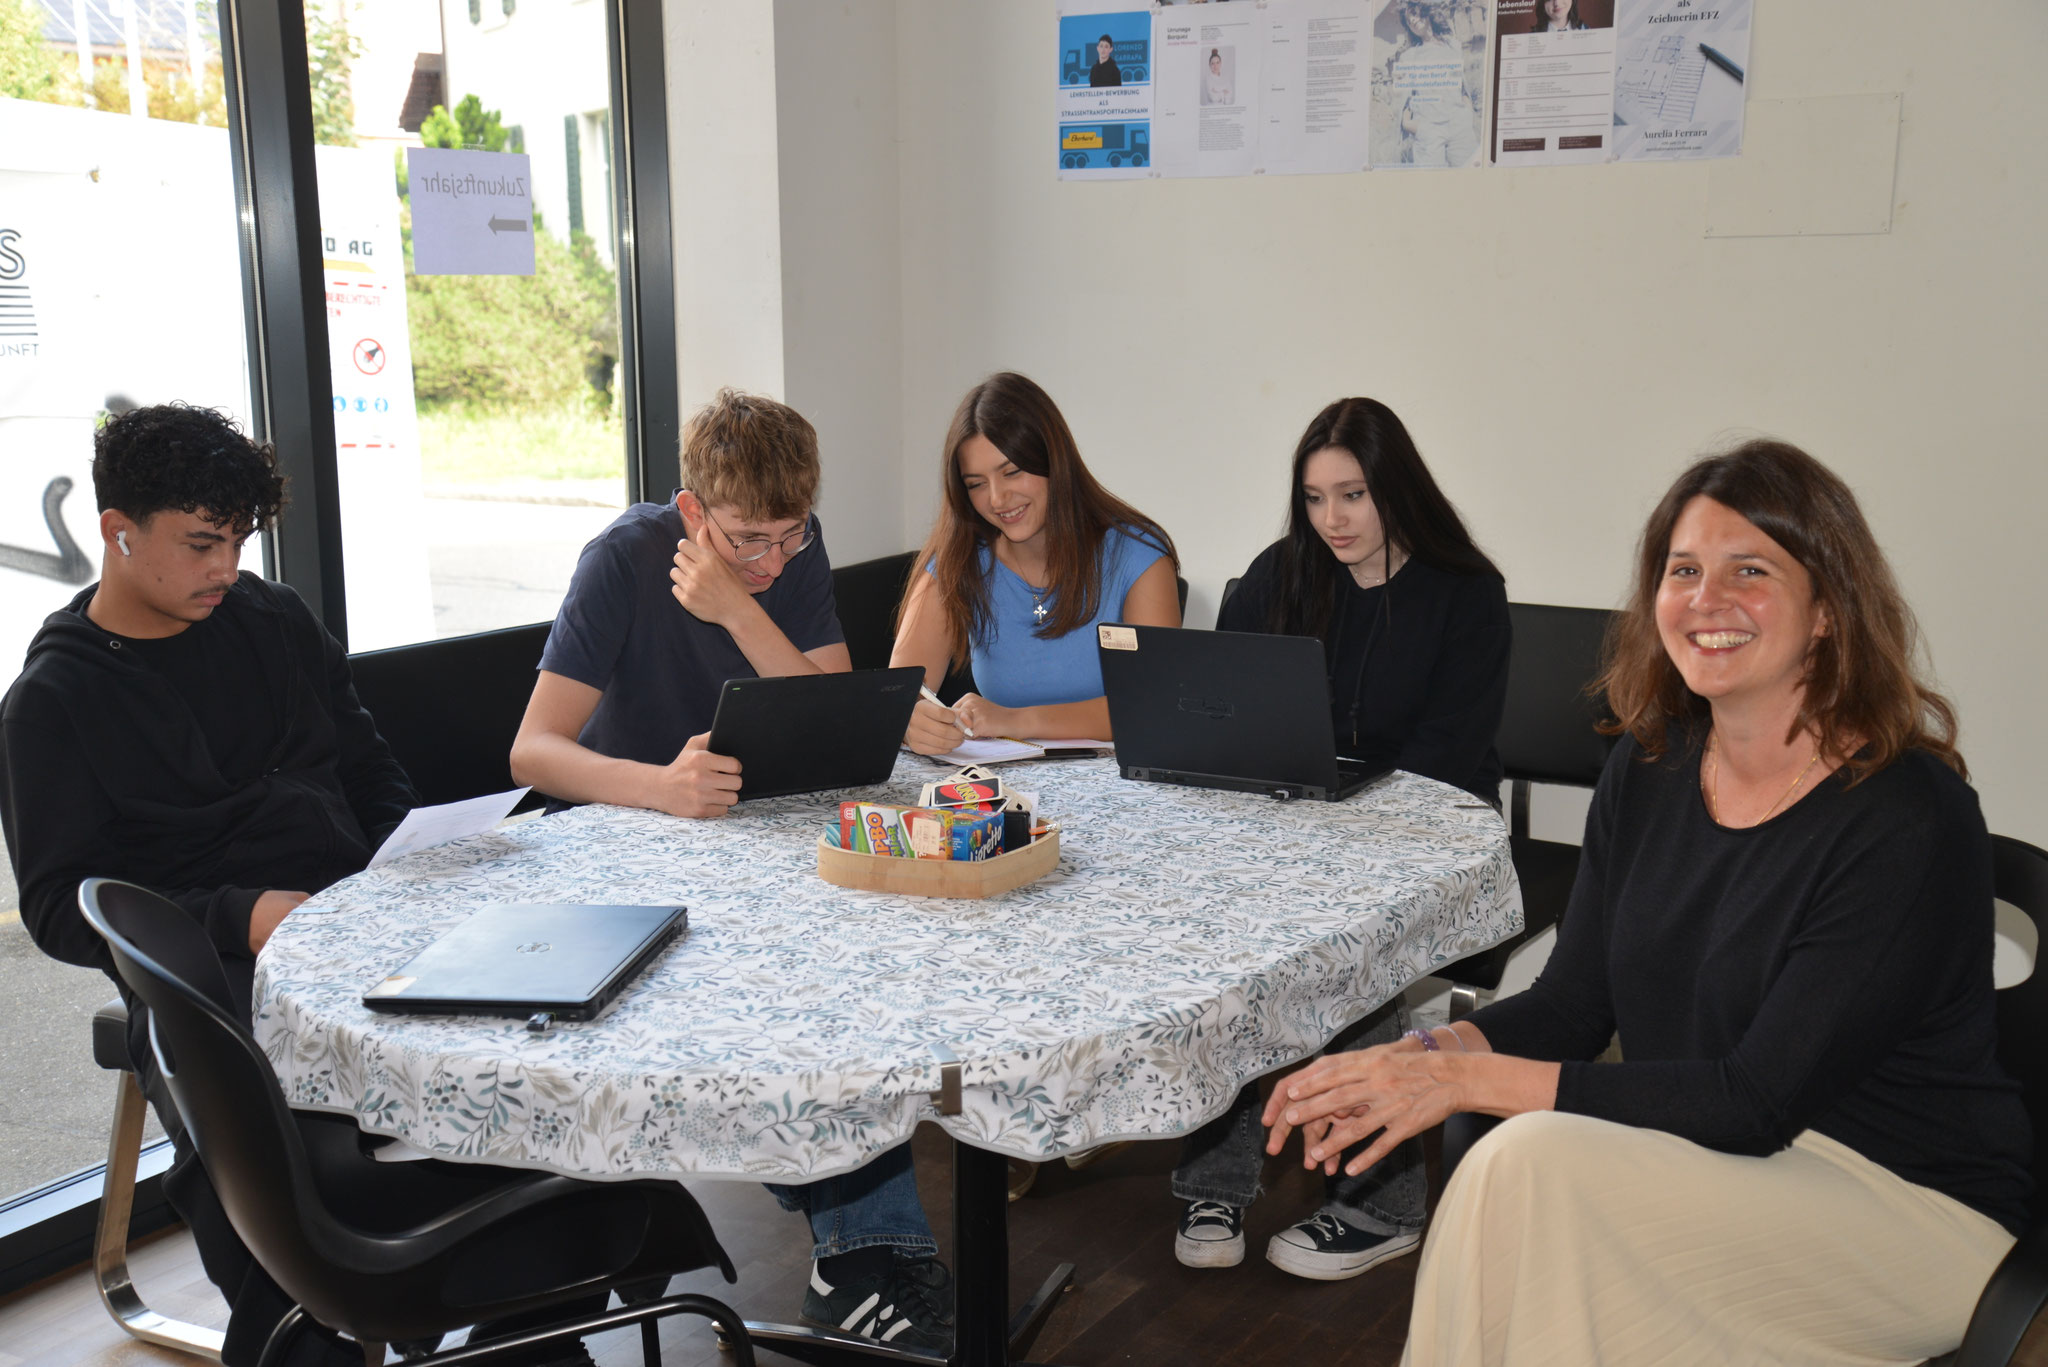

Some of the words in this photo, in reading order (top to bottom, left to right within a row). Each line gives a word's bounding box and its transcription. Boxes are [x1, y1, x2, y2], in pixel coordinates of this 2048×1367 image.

[1648, 12, 1698, 24] Zeichnerin
[1700, 11, 1720, 20] EFZ
[1069, 89, 1140, 98] LEHRSTELLEN-BEWERBUNG
[1061, 108, 1148, 117] STRASSENTRANSPORTFACHMANN
[1643, 129, 1673, 139] Aurelia
[1675, 129, 1708, 138] Ferrara
[349, 240, 373, 256] AG
[954, 783, 980, 801] UNO
[887, 824, 904, 857] NIOR
